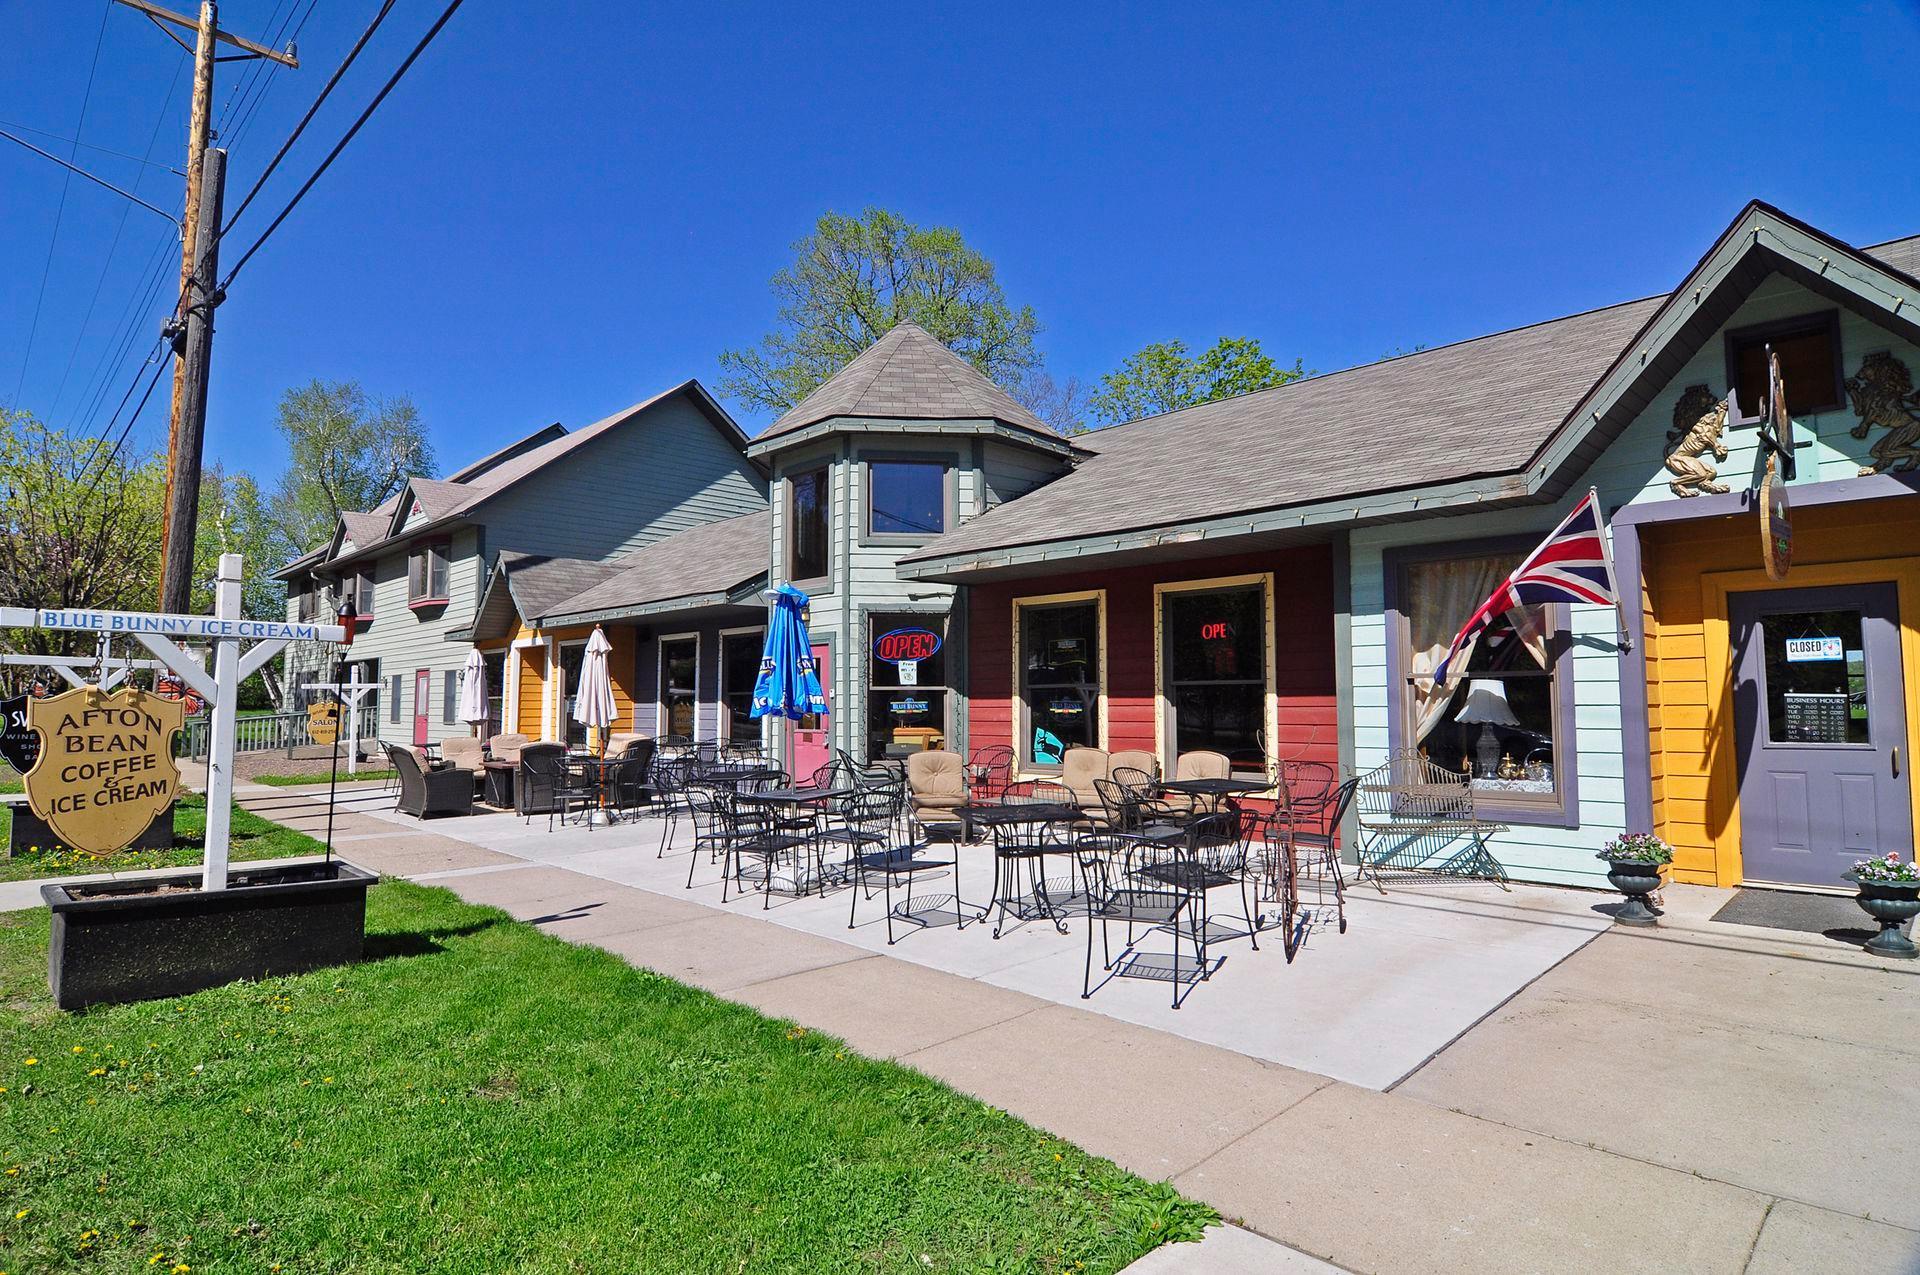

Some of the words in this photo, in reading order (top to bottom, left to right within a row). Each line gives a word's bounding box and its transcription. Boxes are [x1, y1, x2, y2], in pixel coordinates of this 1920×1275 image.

[45, 612, 103, 628] BLUE
[112, 616, 192, 632] BUNNY
[201, 620, 232, 635] ICE
[238, 622, 312, 638] CREAM
[880, 634, 934, 658] OPEN
[1790, 641, 1822, 652] CLOSED
[56, 709, 162, 736] AFTON
[65, 734, 147, 752] BEAN
[61, 754, 156, 783] COFFEE
[103, 776, 134, 788] &
[51, 794, 86, 814] ICE
[94, 780, 167, 806] CREAM
